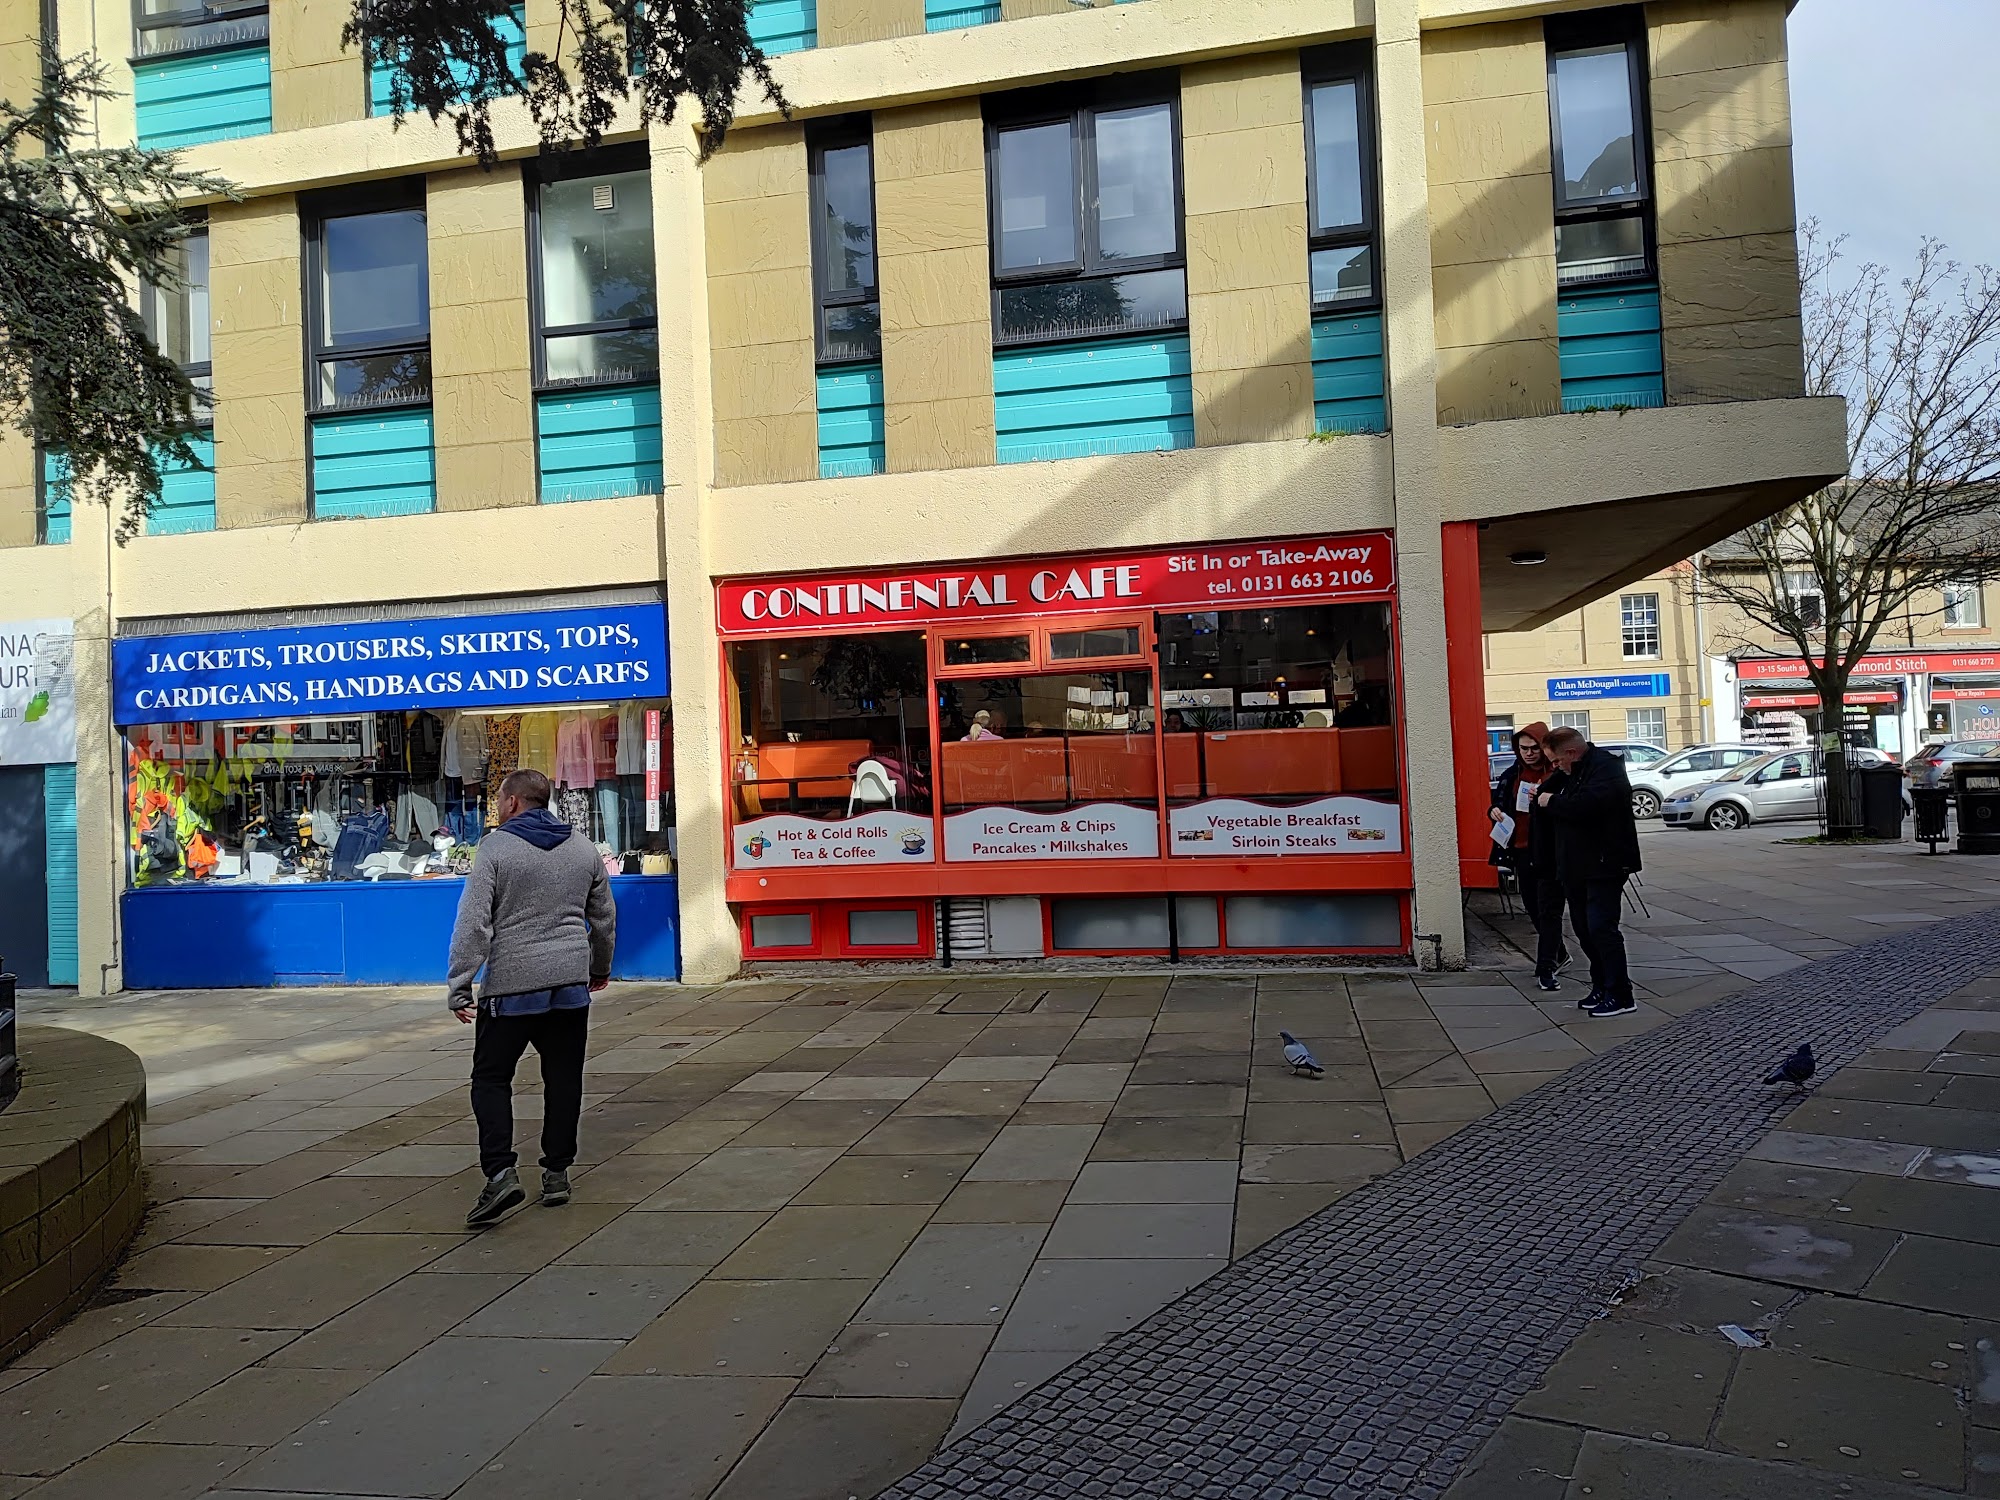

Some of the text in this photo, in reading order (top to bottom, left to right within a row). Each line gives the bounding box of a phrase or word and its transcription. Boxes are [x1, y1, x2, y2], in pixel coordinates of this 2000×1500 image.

[1168, 545, 1372, 573] Sit In or Take-Away
[1206, 569, 1373, 594] tel. 0131 663 2106
[741, 565, 1142, 620] CONTINENTAL CAFE
[146, 623, 639, 673] JACKETS, TROUSERS, SKIRTS, TOPS,
[1757, 665, 1775, 673] 13-15
[1776, 664, 1797, 673] South
[1838, 658, 1892, 672] amond
[1895, 657, 1927, 671] Stitch
[1952, 658, 1968, 667] 0131
[1968, 658, 1979, 666] 660
[1980, 657, 1994, 666] 2772
[135, 660, 650, 709] CARDIGANS, HANDBAGS AND SCARFS
[1554, 681, 1576, 690] Allan
[1577, 678, 1620, 689] McDougall
[1570, 689, 1602, 697] Department
[1969, 690, 1986, 698] Repairs
[1776, 697, 1796, 705] Making
[0, 704, 17, 719] ian
[1963, 719, 1969, 731] 1
[983, 820, 1116, 835] Ice Cream & Chips
[1207, 813, 1361, 830] Vegetable Breakfast
[777, 826, 888, 841] Hot & Cold Rolls
[1231, 834, 1337, 848] Sirloin Steaks
[791, 846, 876, 860] Tea & Coffee
[972, 839, 1128, 854] Pancakes Milkshakes
